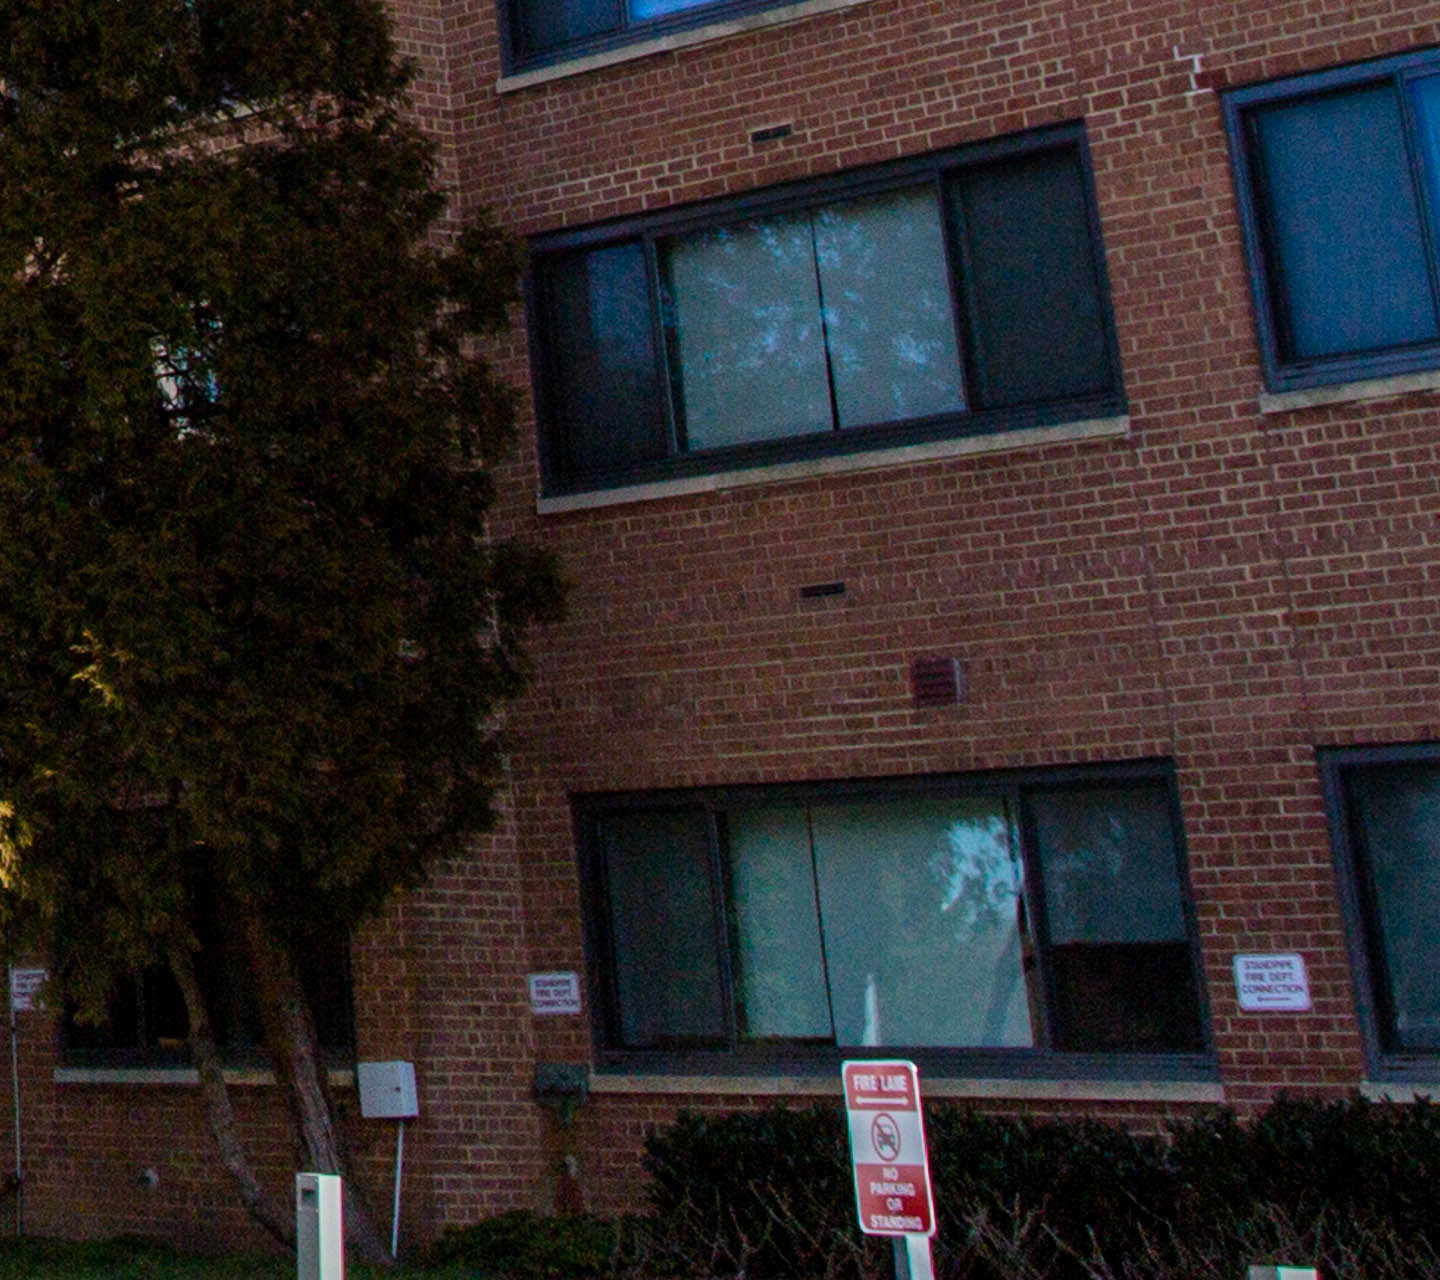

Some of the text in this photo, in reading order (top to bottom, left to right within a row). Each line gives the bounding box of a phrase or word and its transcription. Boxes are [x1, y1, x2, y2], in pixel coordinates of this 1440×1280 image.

[852, 1074, 908, 1092] FIRE LANE
[883, 1167, 899, 1181] NO
[869, 1182, 916, 1197] PARKING
[886, 1197, 903, 1211] OR
[870, 1214, 924, 1231] STANDING
